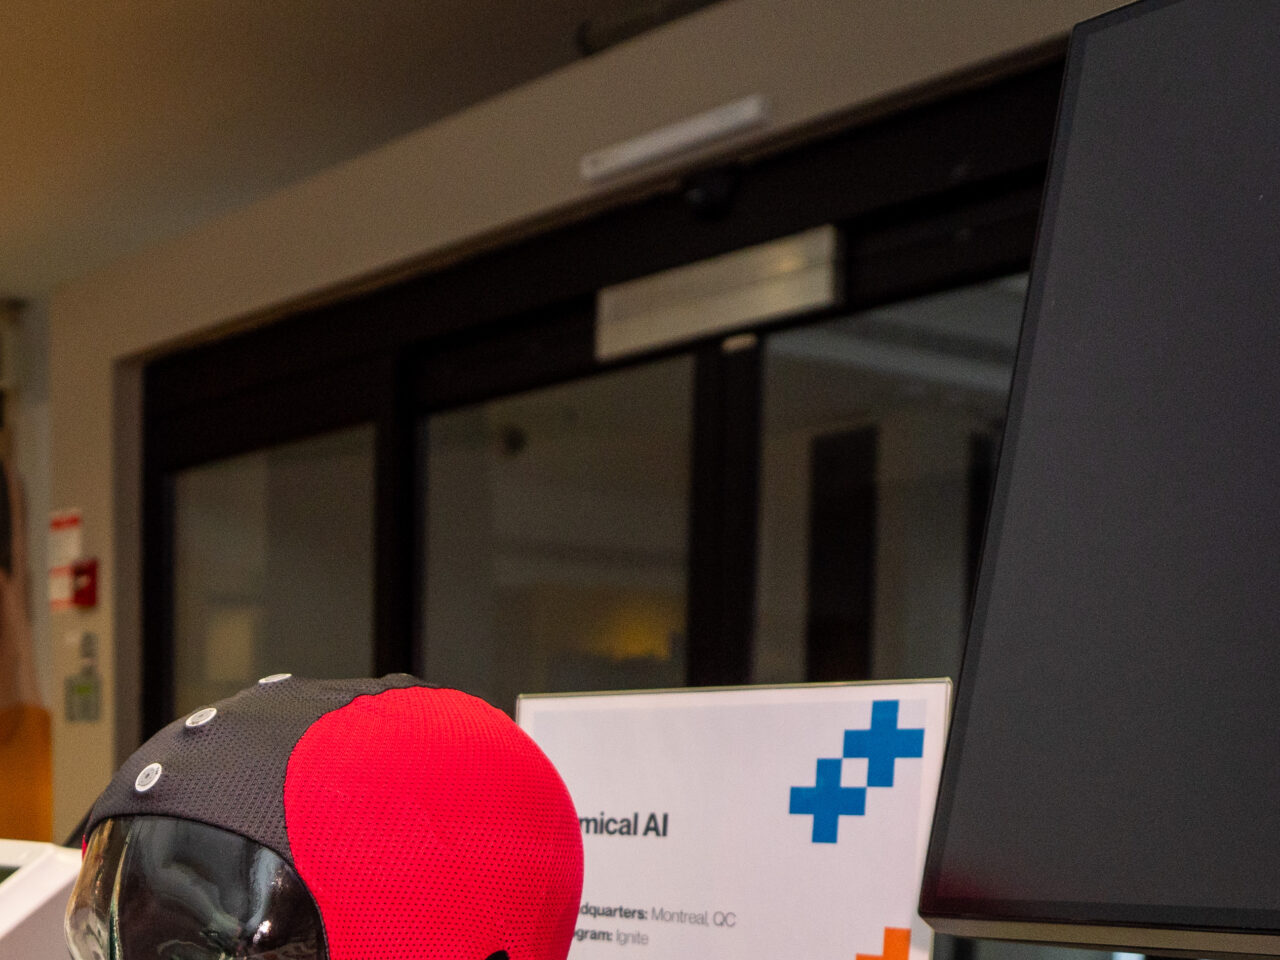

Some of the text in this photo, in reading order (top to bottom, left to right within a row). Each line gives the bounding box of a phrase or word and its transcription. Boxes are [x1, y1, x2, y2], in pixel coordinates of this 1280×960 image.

[578, 812, 668, 837] mical AI
[579, 903, 648, 921] dquarters:
[713, 911, 737, 928] QC
[616, 929, 649, 946] Ignite
